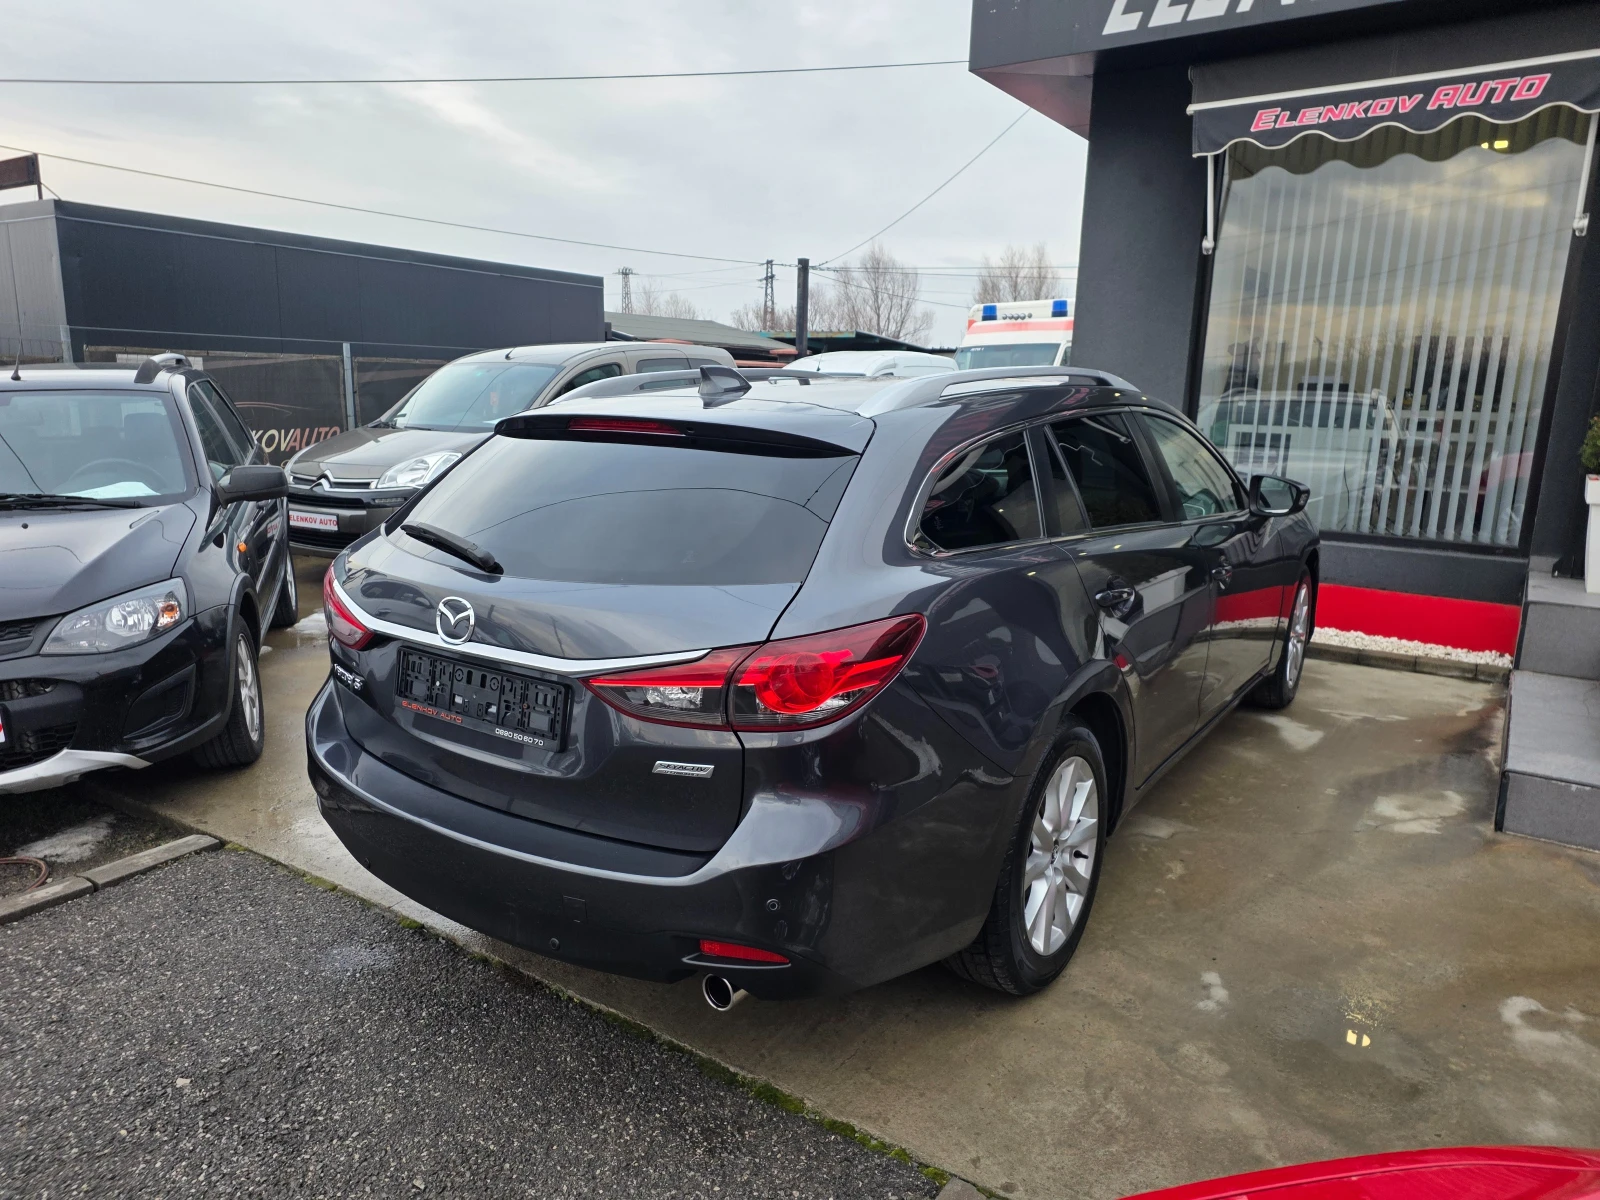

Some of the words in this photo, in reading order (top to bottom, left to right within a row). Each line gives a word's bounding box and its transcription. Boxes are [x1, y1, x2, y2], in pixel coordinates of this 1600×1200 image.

[1251, 94, 1423, 132] ELENKOV
[1427, 73, 1551, 110] AUTO
[289, 514, 318, 524] ELENKOV
[319, 518, 338, 527] AUTO
[440, 712, 462, 723] AUTO
[534, 738, 544, 746] 70
[659, 763, 707, 772] SKYACTIV
